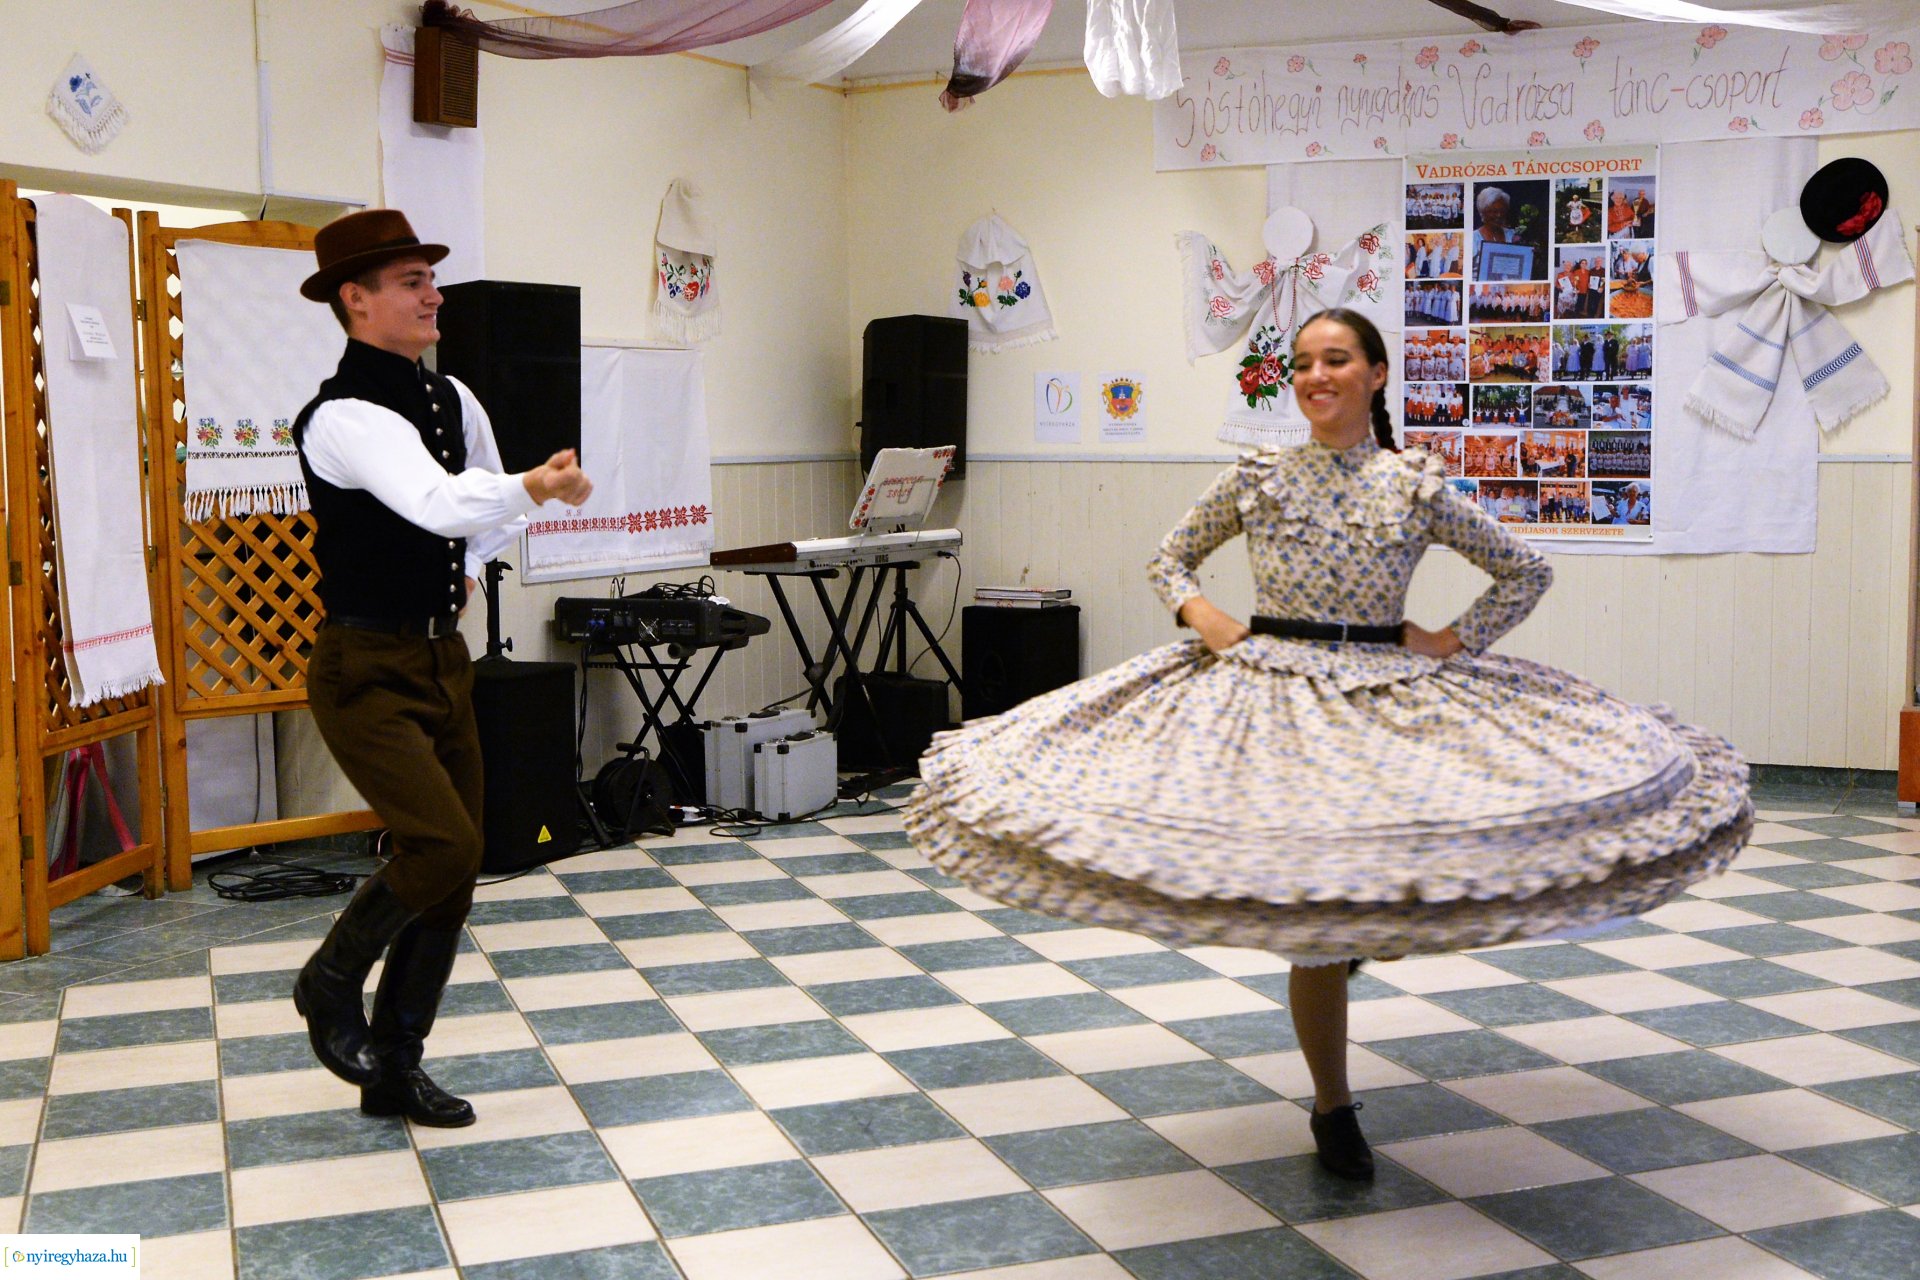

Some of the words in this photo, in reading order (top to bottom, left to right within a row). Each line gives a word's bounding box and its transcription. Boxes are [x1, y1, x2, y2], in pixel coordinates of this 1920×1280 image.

[1447, 62, 1574, 129] Vadrózsa
[1608, 45, 1791, 118] tánc-csoport
[1416, 162, 1507, 179] VADRÓZSA
[1512, 158, 1642, 176] TÁNCCSOPORT
[1561, 526, 1624, 536] SZERVEZETE
